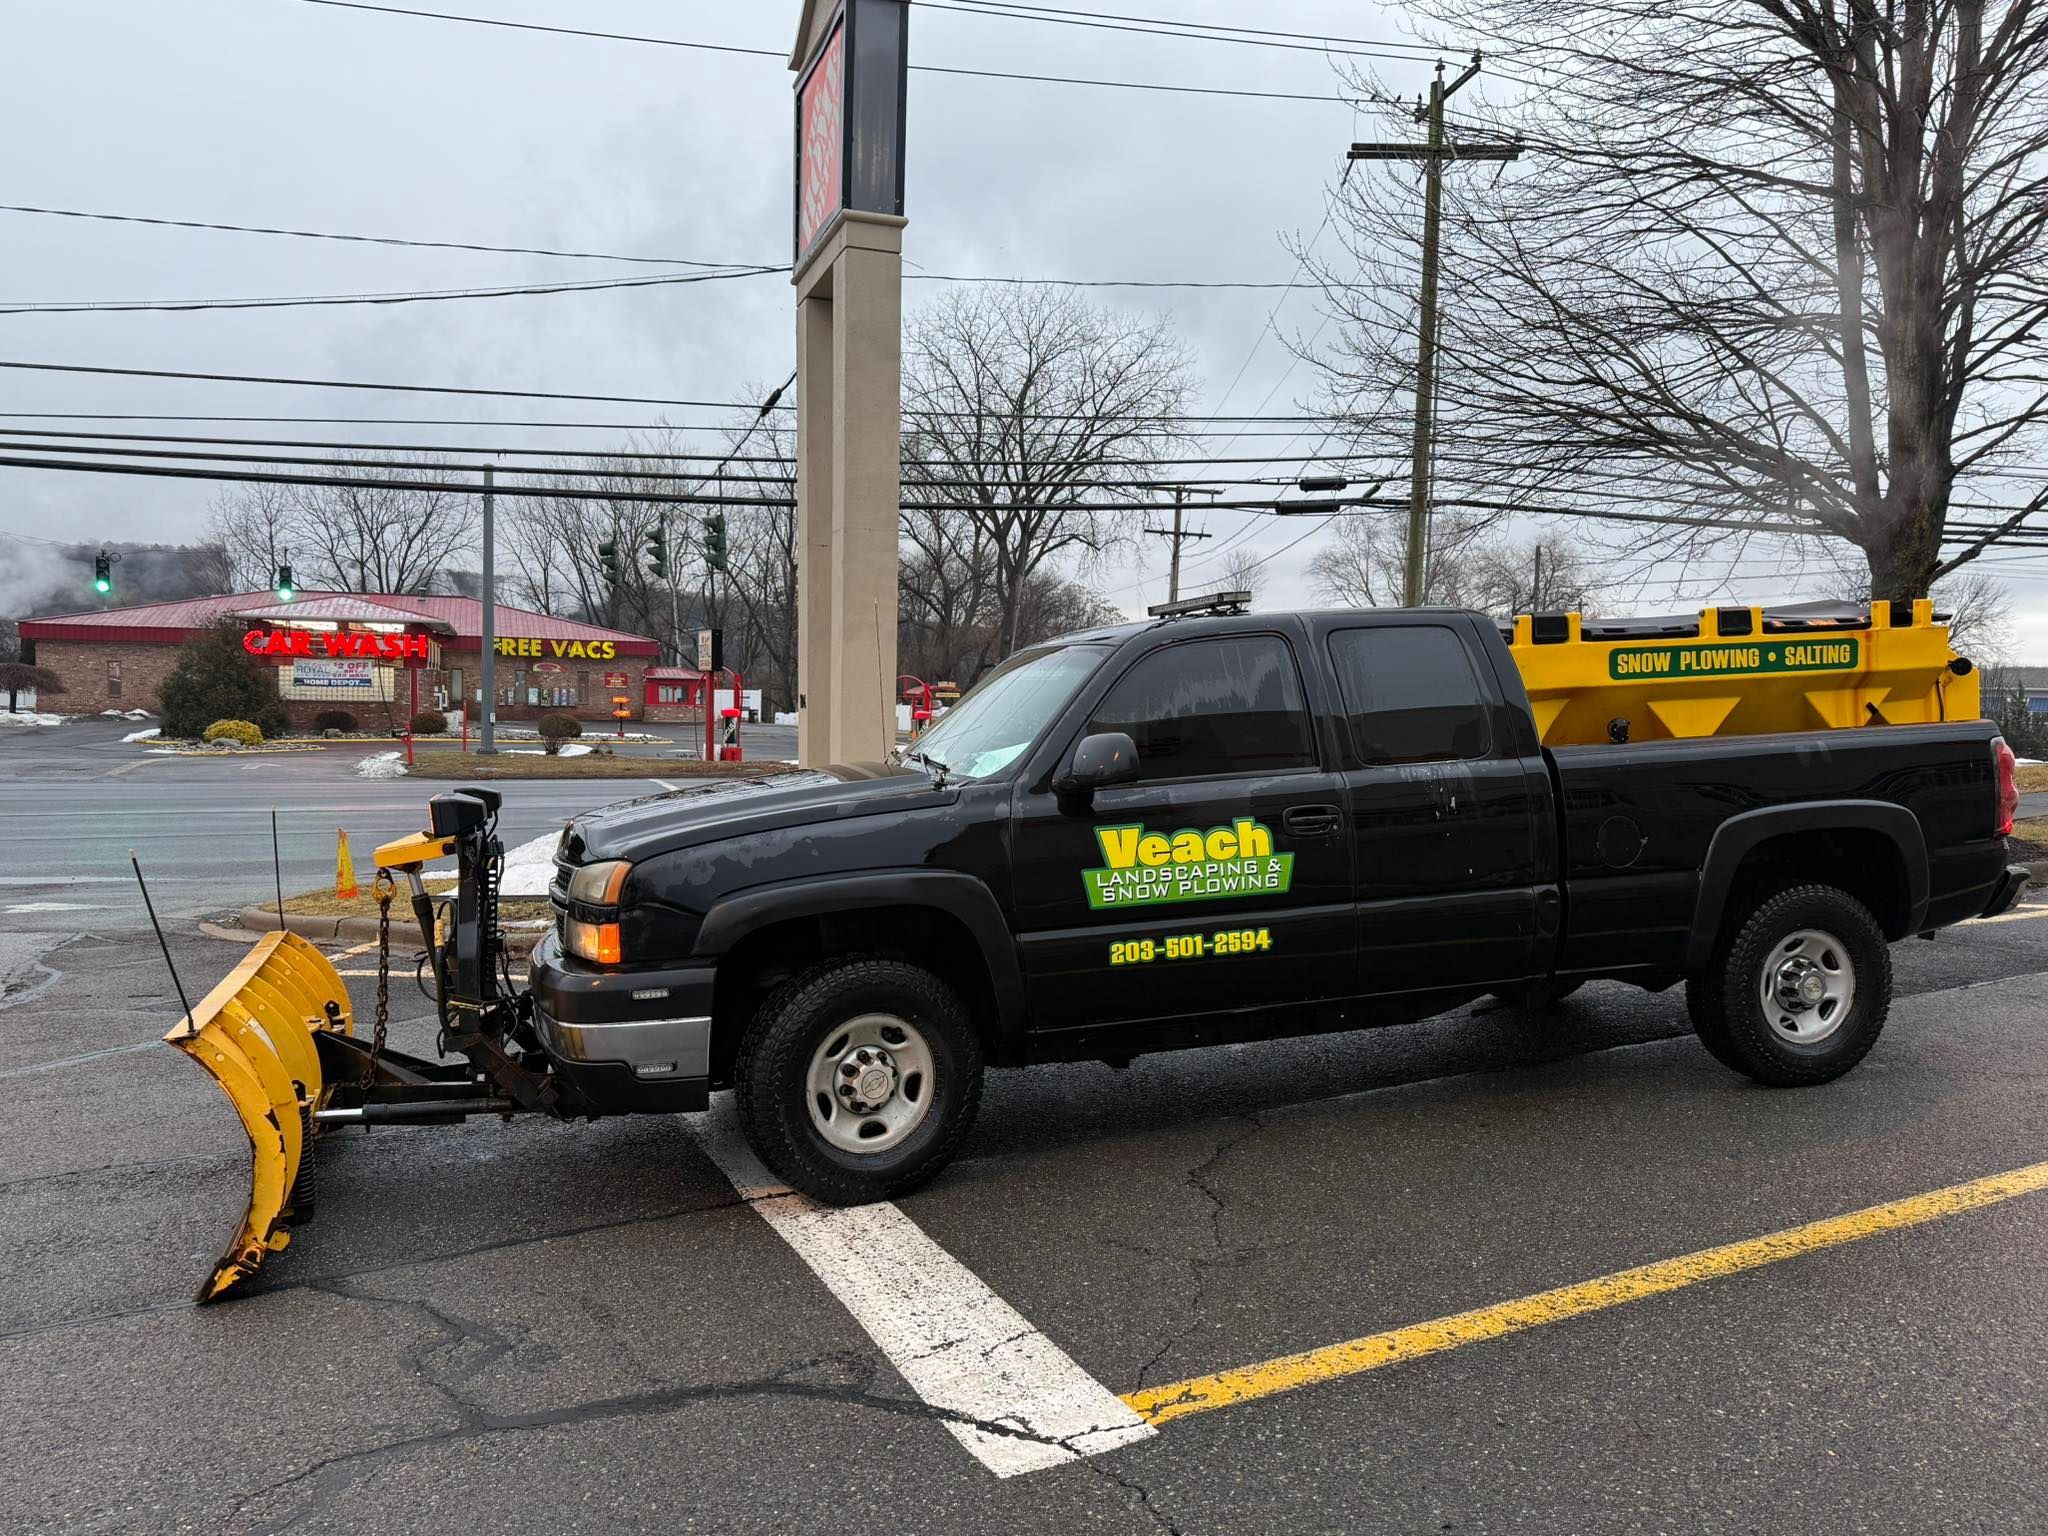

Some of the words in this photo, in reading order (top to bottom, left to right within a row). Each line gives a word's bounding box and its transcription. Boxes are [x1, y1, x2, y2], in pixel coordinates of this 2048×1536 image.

[243, 629, 312, 656] CAR
[322, 632, 427, 659] WASH
[550, 640, 615, 659] VACS
[1617, 651, 1671, 674] SNOW
[1680, 648, 1760, 671] PLOWING
[1784, 644, 1851, 666] SALTING
[296, 665, 330, 674] ROYAL
[347, 662, 369, 670] OFF
[1099, 821, 1270, 869] Veach
[1096, 861, 1258, 888] LANDSCAPING
[1268, 858, 1282, 873] &
[1103, 883, 1170, 903] SNOW
[1179, 873, 1280, 896] PLOWING
[1111, 928, 1271, 964] 203-501-2594
